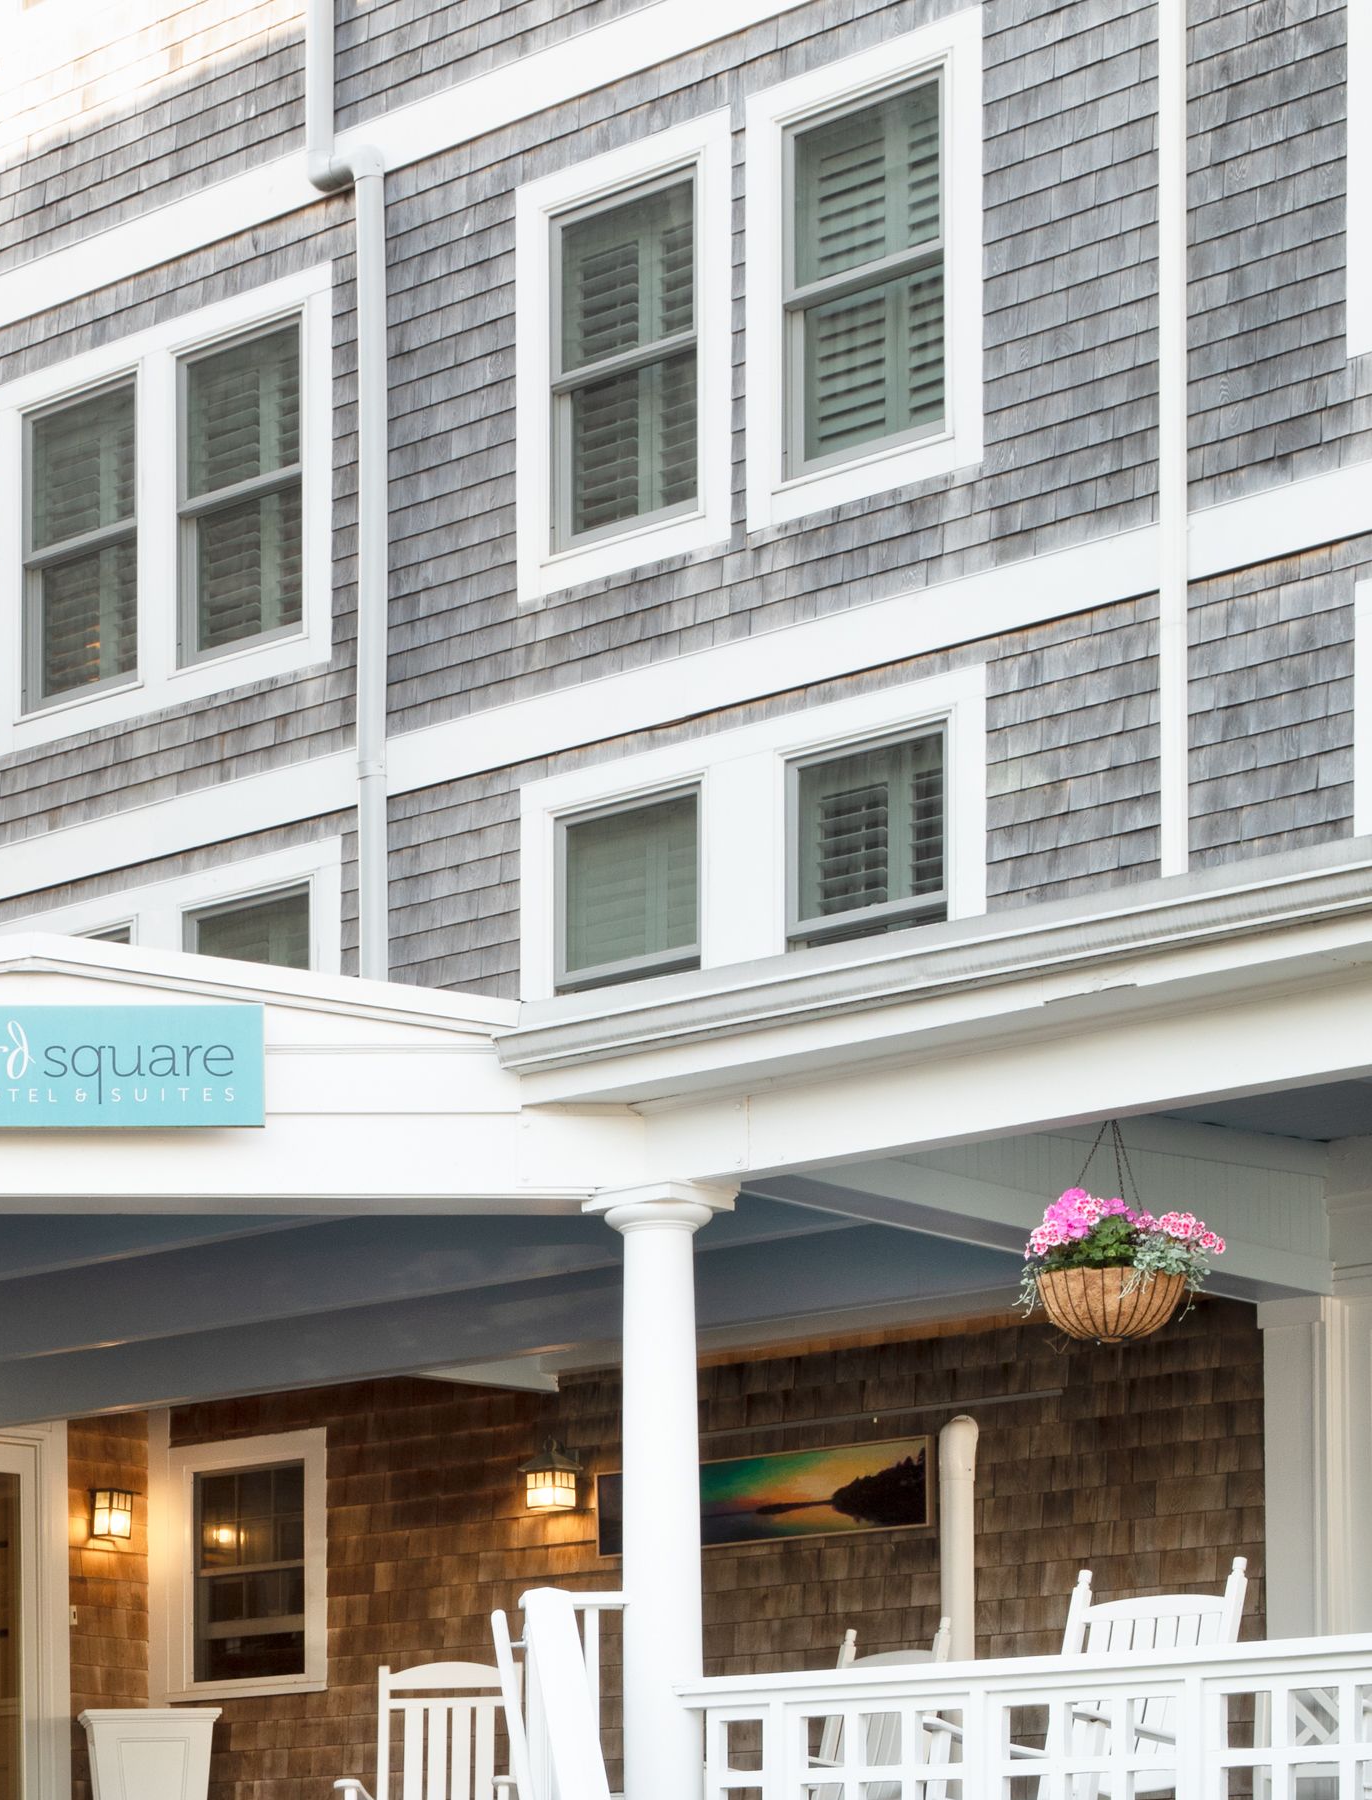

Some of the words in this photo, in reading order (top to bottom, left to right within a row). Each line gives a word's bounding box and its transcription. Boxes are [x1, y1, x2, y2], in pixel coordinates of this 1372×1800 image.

[43, 1045, 235, 1105] square
[75, 1088, 87, 1103] &
[111, 1087, 235, 1102] SUITES
